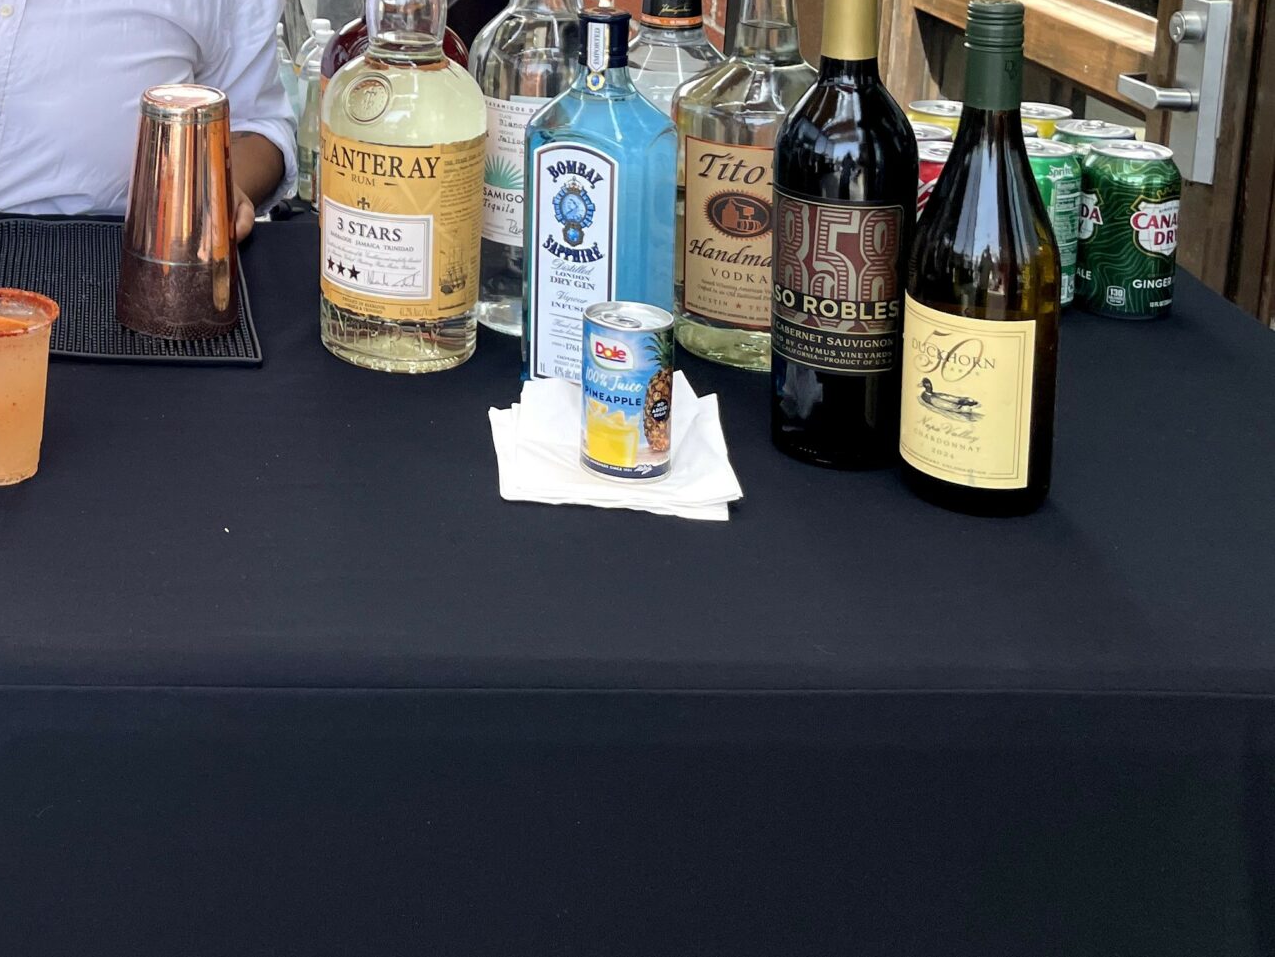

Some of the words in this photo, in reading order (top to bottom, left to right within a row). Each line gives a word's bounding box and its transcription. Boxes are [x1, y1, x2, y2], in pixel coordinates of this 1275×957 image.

[351, 174, 376, 187] RUM
[546, 160, 604, 189] BOMBAY
[337, 217, 344, 230] 3
[348, 221, 402, 242] STARS
[1132, 212, 1178, 230] CANA
[355, 240, 380, 250] JAMAICA
[1154, 230, 1177, 245] DR
[542, 234, 603, 263] SAPPHIRE
[688, 238, 772, 268] Handma
[550, 276, 572, 286] DRY
[574, 280, 596, 291] GIN
[555, 271, 590, 281] LONDON
[711, 267, 768, 284] VODKA
[1132, 276, 1172, 289] GINGER
[803, 297, 899, 320] ROBLES
[776, 321, 823, 343] CABERNET
[826, 336, 893, 348] SAUVIGNON
[595, 341, 626, 360] Dole
[797, 342, 837, 356] CAYMUS
[840, 350, 892, 359] VINEYARDS
[608, 375, 643, 393] Juice
[584, 386, 642, 406] PINEAPPLE
[917, 415, 940, 432] Napa
[941, 423, 979, 444] Valley
[913, 428, 981, 452] CHARDONNAY
